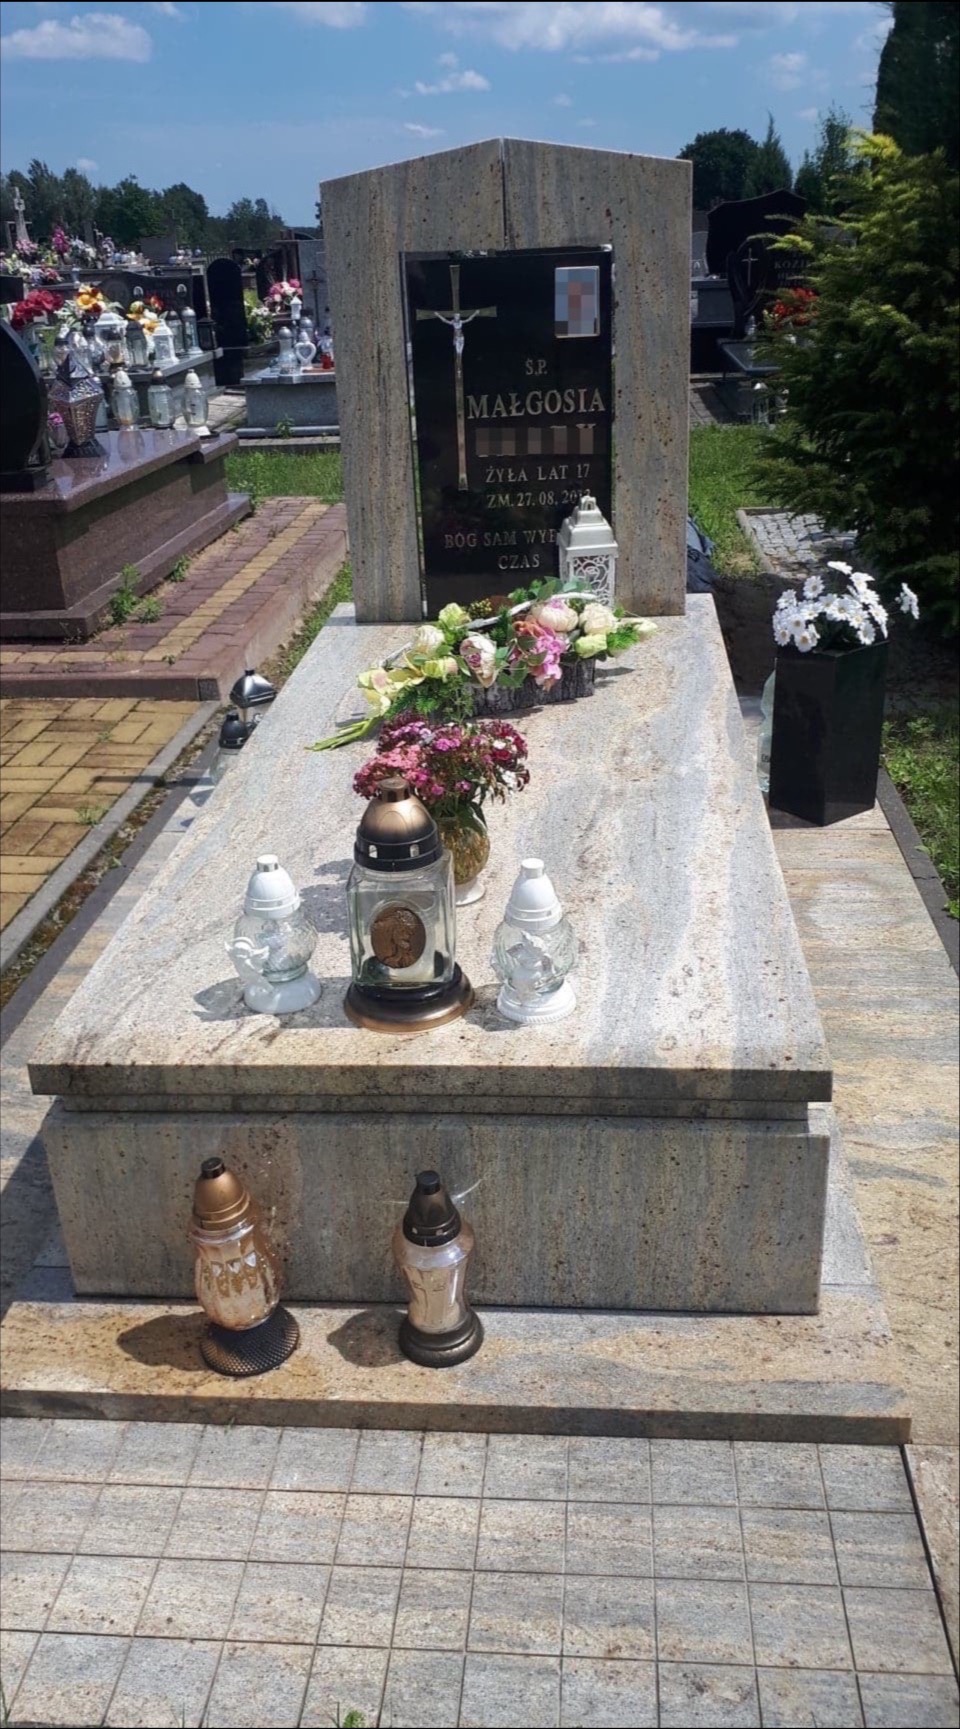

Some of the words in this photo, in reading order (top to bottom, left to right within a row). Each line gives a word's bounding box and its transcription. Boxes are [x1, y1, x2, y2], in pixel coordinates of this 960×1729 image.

[466, 388, 606, 420] MAŁGOSIA
[485, 465, 529, 483] ŻYŁA
[537, 464, 569, 481] LAT
[576, 463, 590, 479] 17
[483, 530, 517, 546] SAM
[497, 553, 540, 570] CZAS
